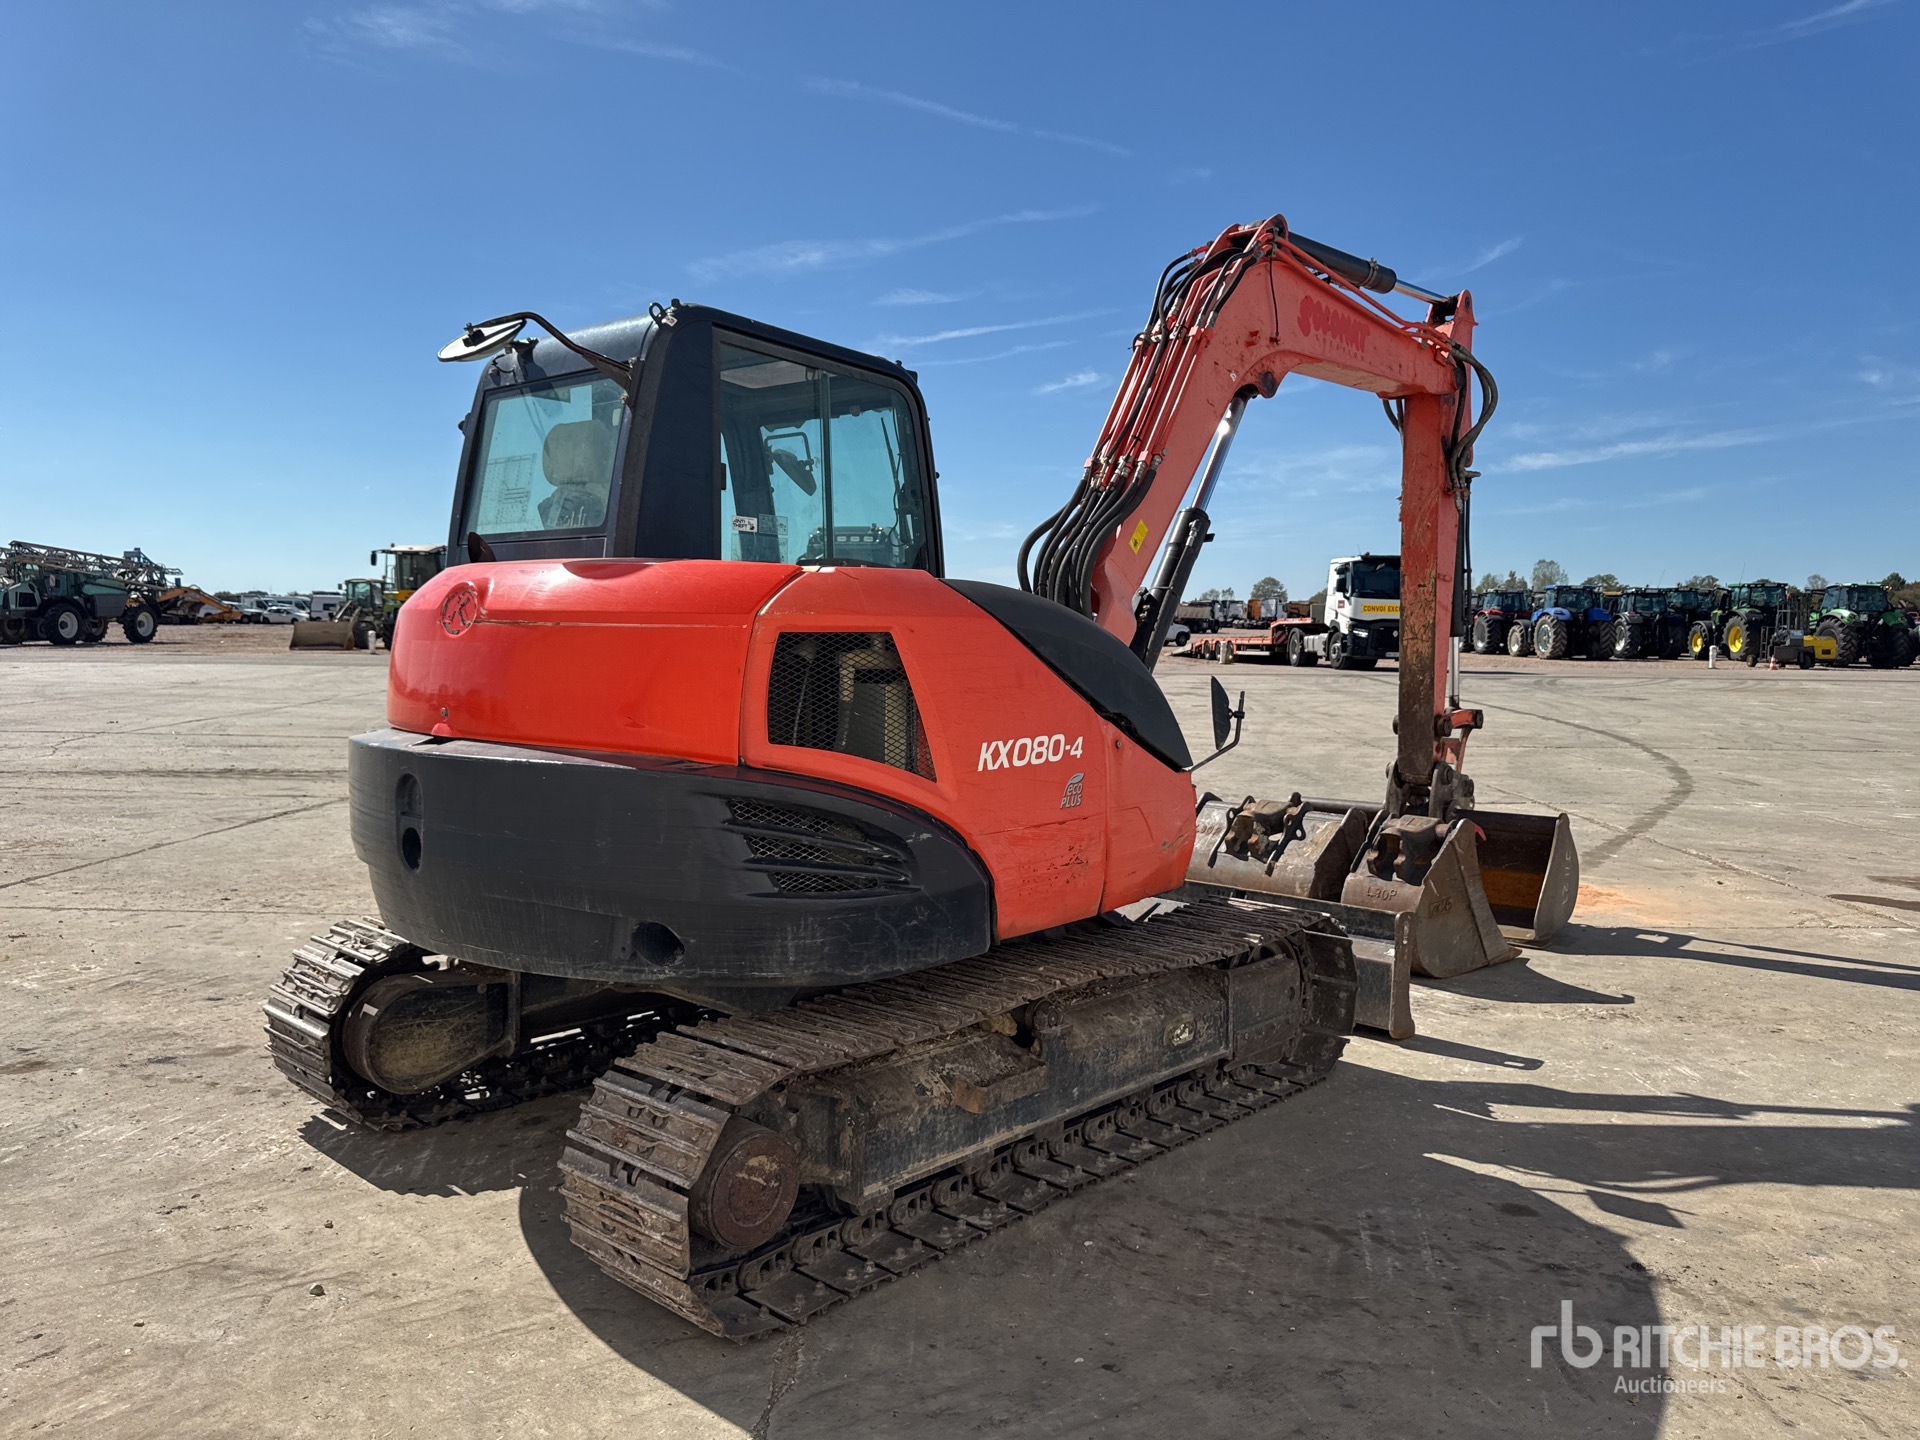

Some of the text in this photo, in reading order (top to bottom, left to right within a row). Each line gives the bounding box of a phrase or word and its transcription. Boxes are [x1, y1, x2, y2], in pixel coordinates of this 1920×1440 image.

[1362, 605, 1386, 613] CONVOI
[977, 734, 1083, 772] KX080-4
[1060, 795, 1083, 810] PLUS
